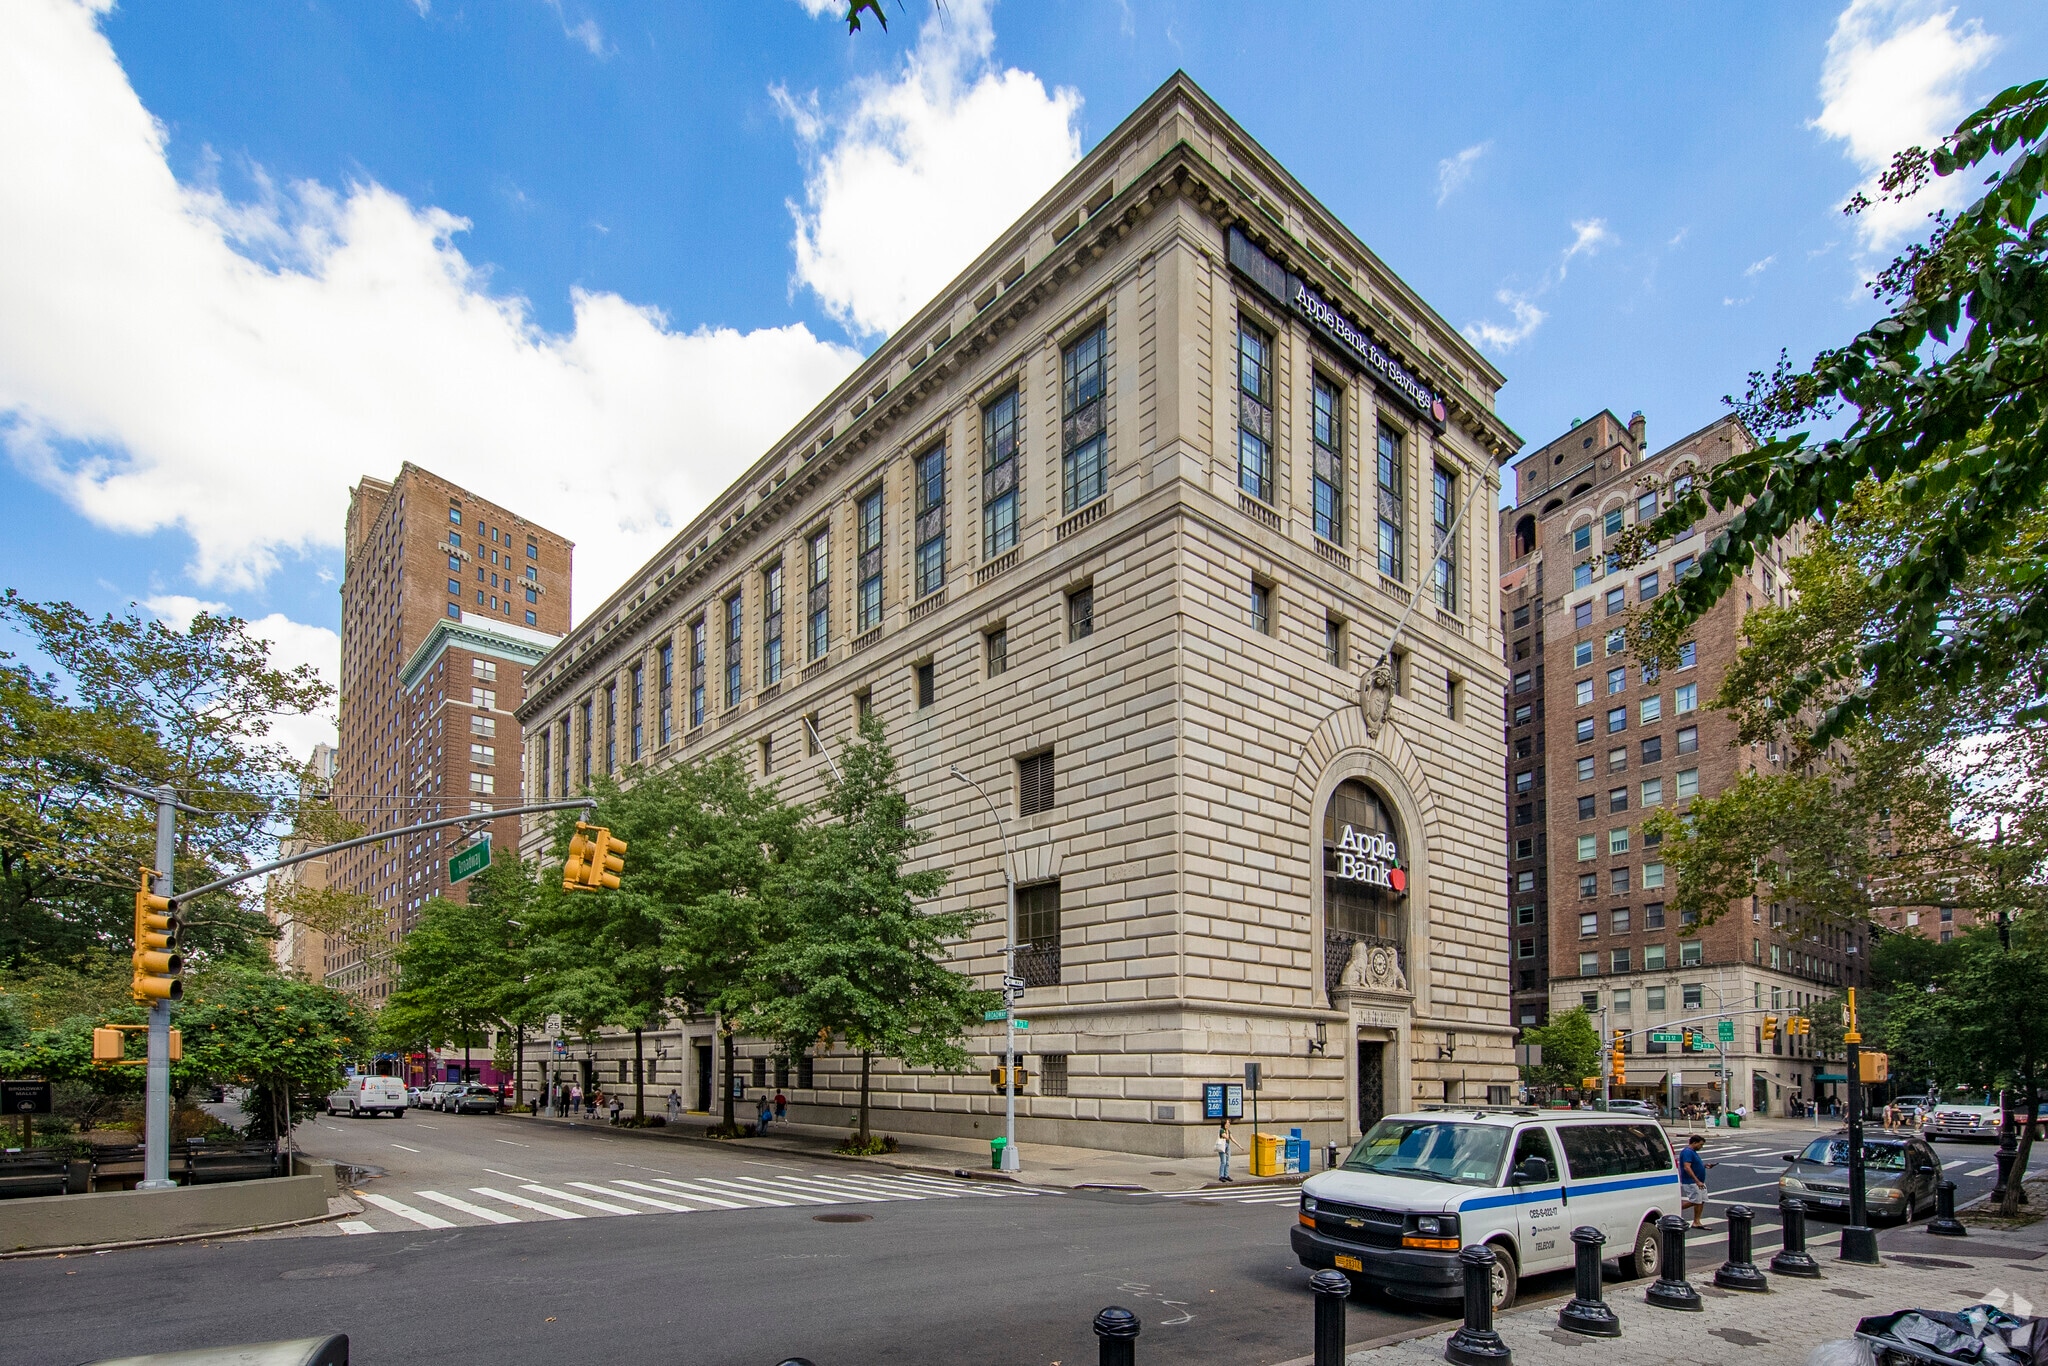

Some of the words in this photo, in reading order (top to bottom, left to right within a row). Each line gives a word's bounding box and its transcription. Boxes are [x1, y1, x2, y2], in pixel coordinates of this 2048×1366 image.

[1295, 285, 1334, 327] Apple
[1334, 315, 1367, 358] Bank
[1369, 345, 1387, 372] for
[1388, 361, 1431, 408] Savings
[1336, 824, 1396, 861] Apple
[1336, 852, 1392, 888] Bank
[1228, 1098, 1239, 1106] 1.65
[1536, 1240, 1556, 1251] TELECOM
